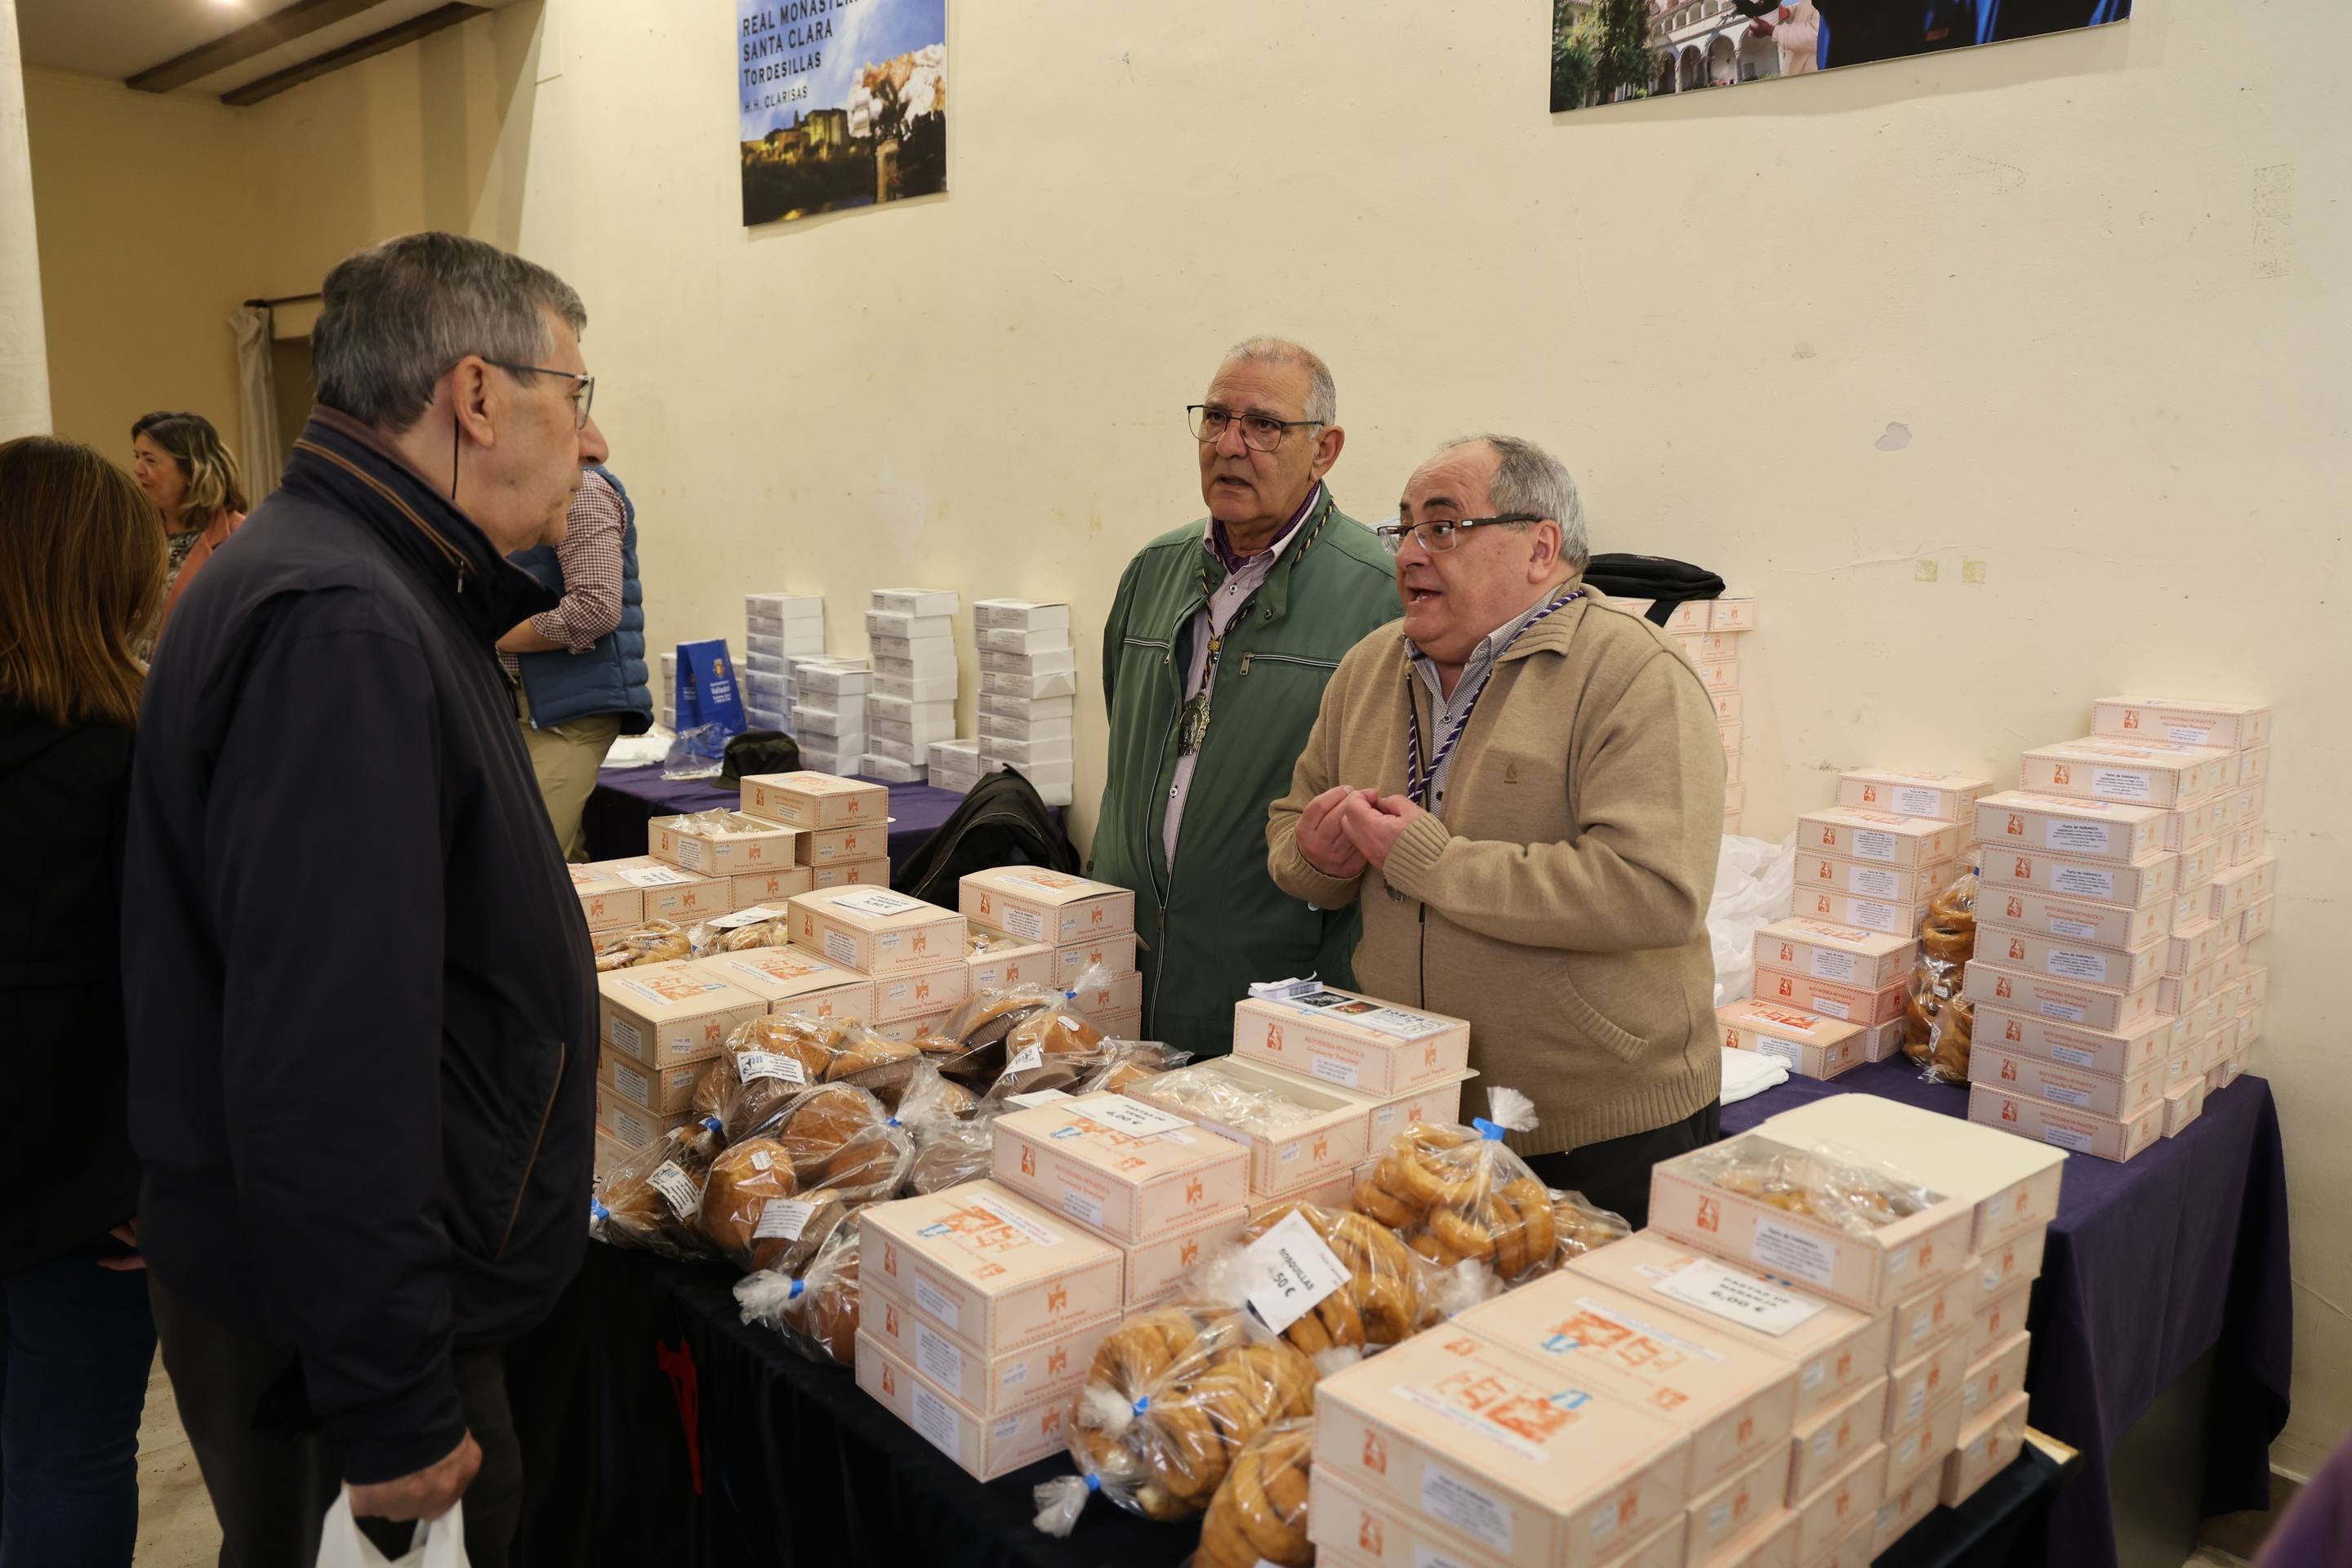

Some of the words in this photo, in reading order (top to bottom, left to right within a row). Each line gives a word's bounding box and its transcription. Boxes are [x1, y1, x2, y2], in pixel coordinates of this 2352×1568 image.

[743, 11, 775, 37] REAL
[743, 33, 783, 62] SANTA
[789, 18, 833, 48] CLARA
[744, 51, 821, 87] TORDESILLAS
[765, 86, 808, 109] CLARISAS
